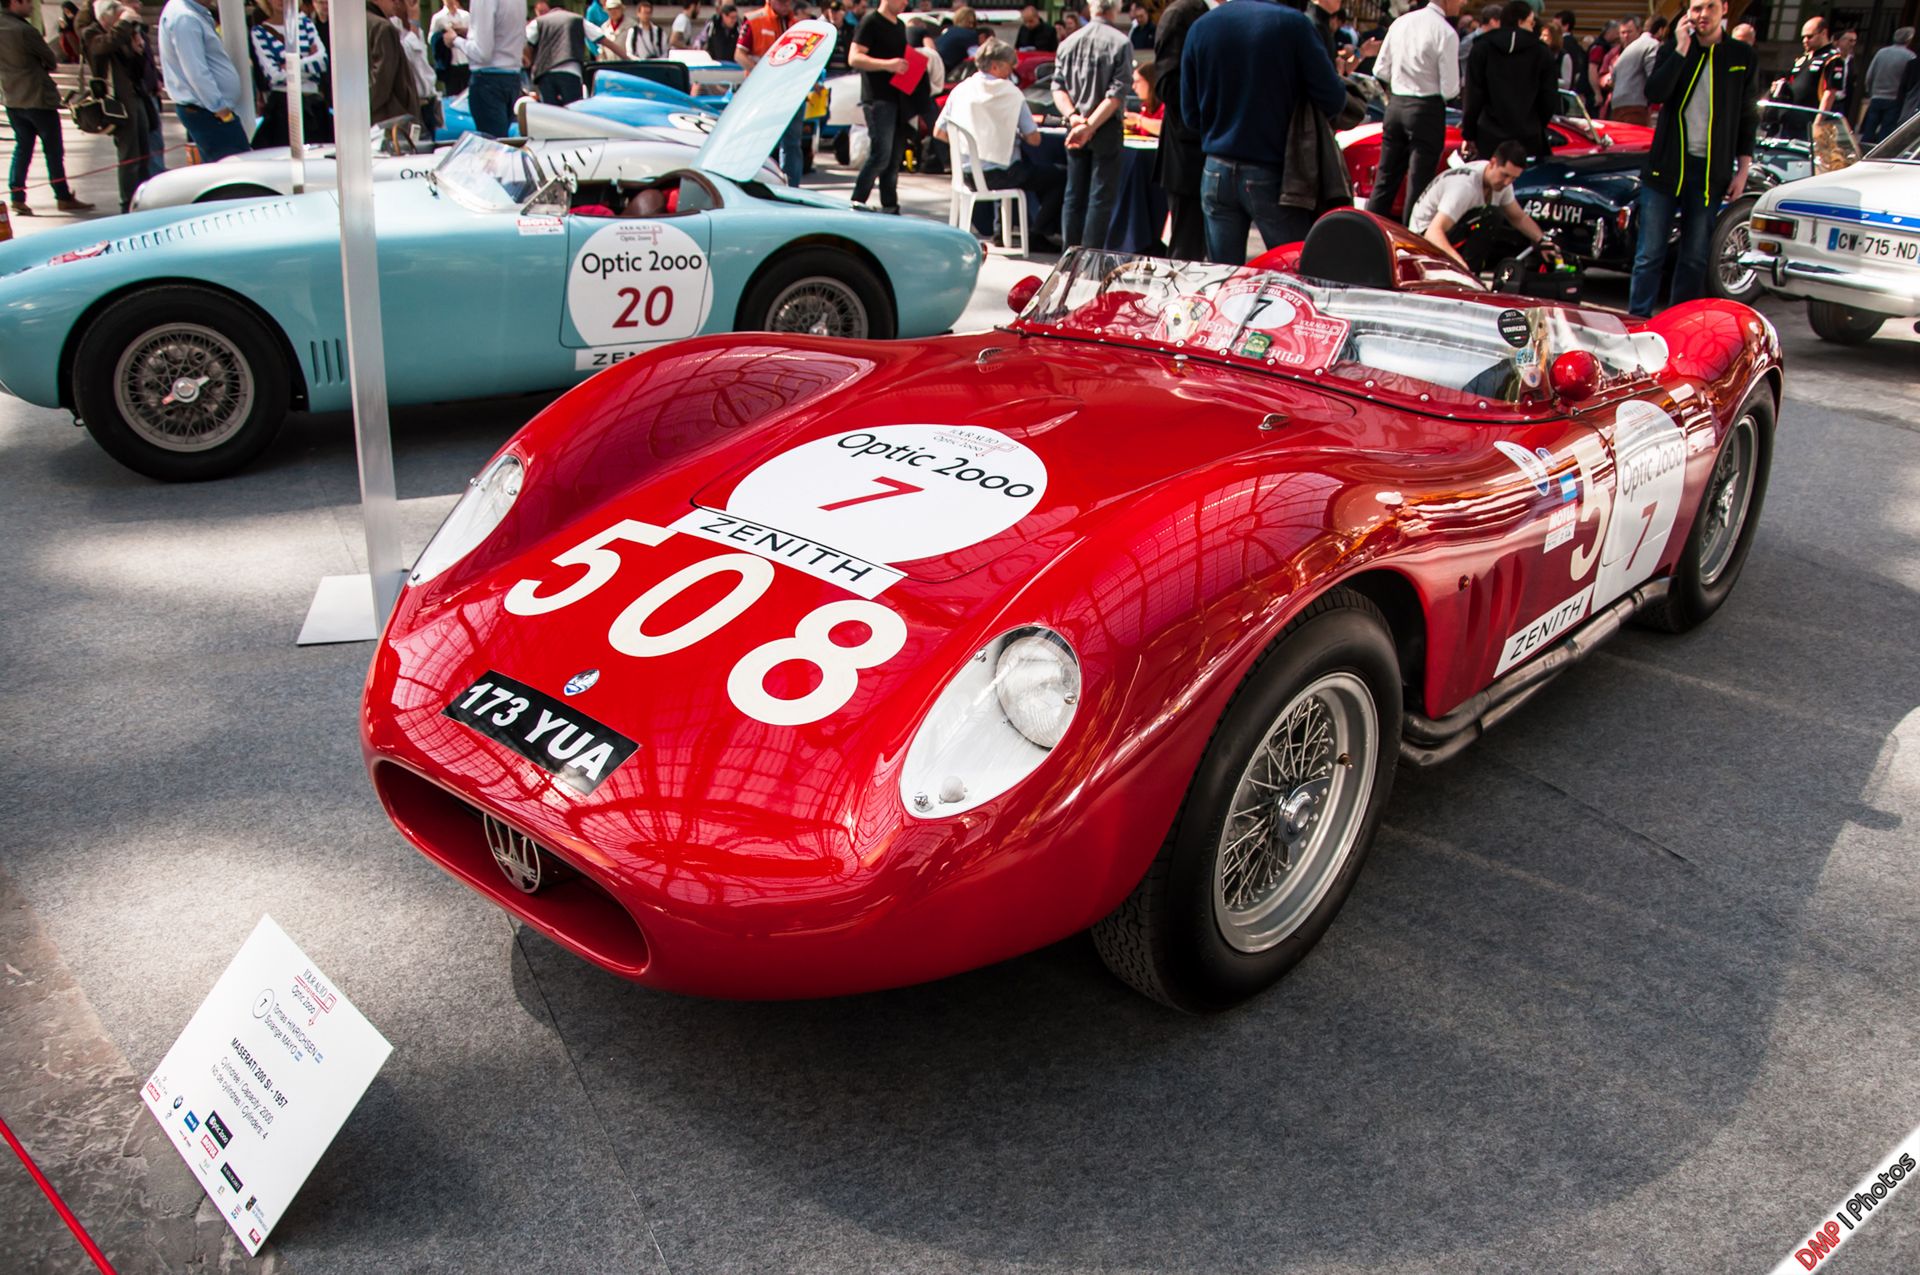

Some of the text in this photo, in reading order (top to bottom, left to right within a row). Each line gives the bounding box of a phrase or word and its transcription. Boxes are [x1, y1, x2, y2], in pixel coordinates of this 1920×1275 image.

[1524, 200, 1583, 224] 424 UYH
[582, 250, 702, 280] Optic 2000
[612, 285, 674, 329] 20
[1247, 298, 1274, 321] 7
[837, 432, 1035, 499] Optic 2000
[1622, 443, 1683, 502] Optic 2000
[817, 475, 925, 511] 7
[700, 517, 873, 582] ZENITH
[1625, 500, 1658, 571] 7
[504, 518, 908, 726] 508
[1510, 596, 1584, 660] ZENITH
[460, 682, 614, 782] 173 YUA
[281, 1034, 298, 1055] MAYO
[231, 1037, 258, 1072] MASERATI
[254, 1067, 267, 1083] 200
[264, 1079, 273, 1091] SI
[273, 1090, 288, 1109] 1957
[260, 1106, 274, 1125] 2000
[262, 1132, 269, 1140] 4
